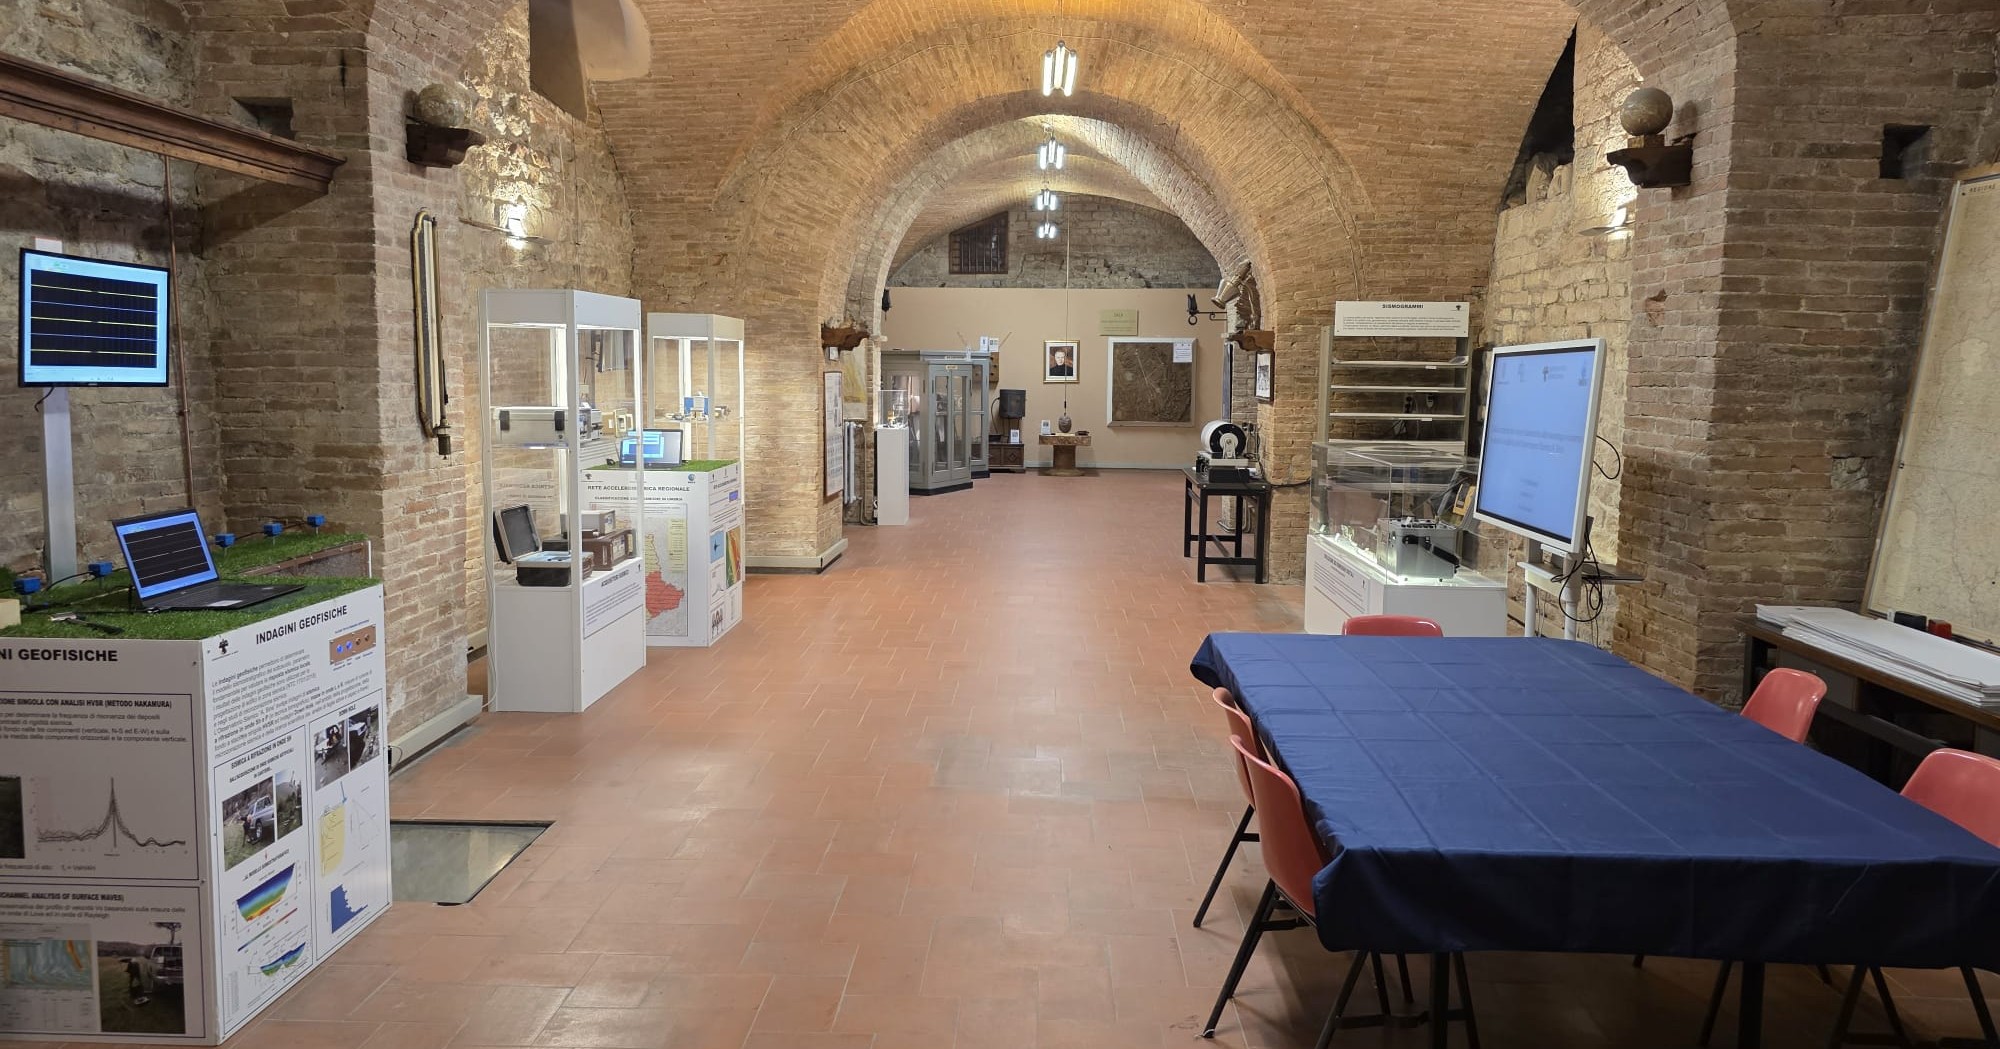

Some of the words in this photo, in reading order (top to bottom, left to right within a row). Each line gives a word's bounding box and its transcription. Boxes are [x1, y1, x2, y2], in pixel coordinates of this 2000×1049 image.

[256, 621, 297, 645] INDAGINI
[299, 605, 347, 630] GEOFISICHE
[18, 649, 118, 661] GEOFISICHE
[17, 698, 44, 706] SINGOLA
[61, 699, 84, 707] ANALISI
[105, 700, 132, 708] (METODO
[134, 700, 172, 709] NAKAMURA)
[31, 892, 61, 900] ANALYSIS
